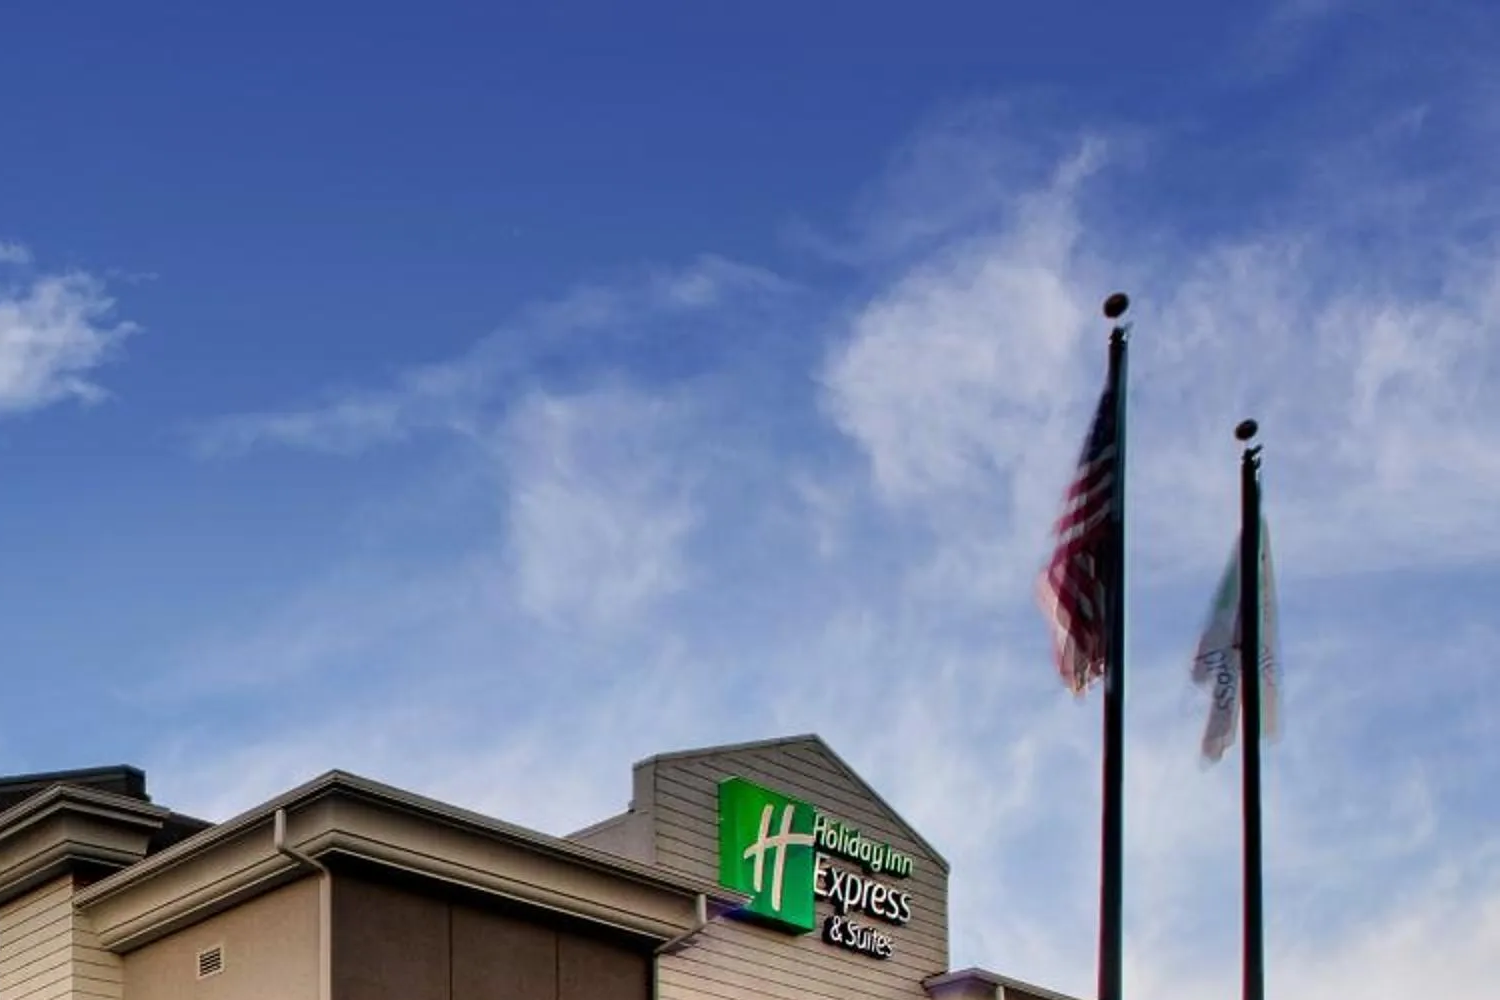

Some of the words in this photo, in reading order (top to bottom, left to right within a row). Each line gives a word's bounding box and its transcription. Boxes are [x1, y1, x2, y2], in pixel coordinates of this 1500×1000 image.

[814, 814, 881, 872] Holiday
[885, 847, 913, 875] Inn
[813, 851, 912, 923] Express
[830, 915, 843, 942] &
[845, 921, 893, 957] Suites
